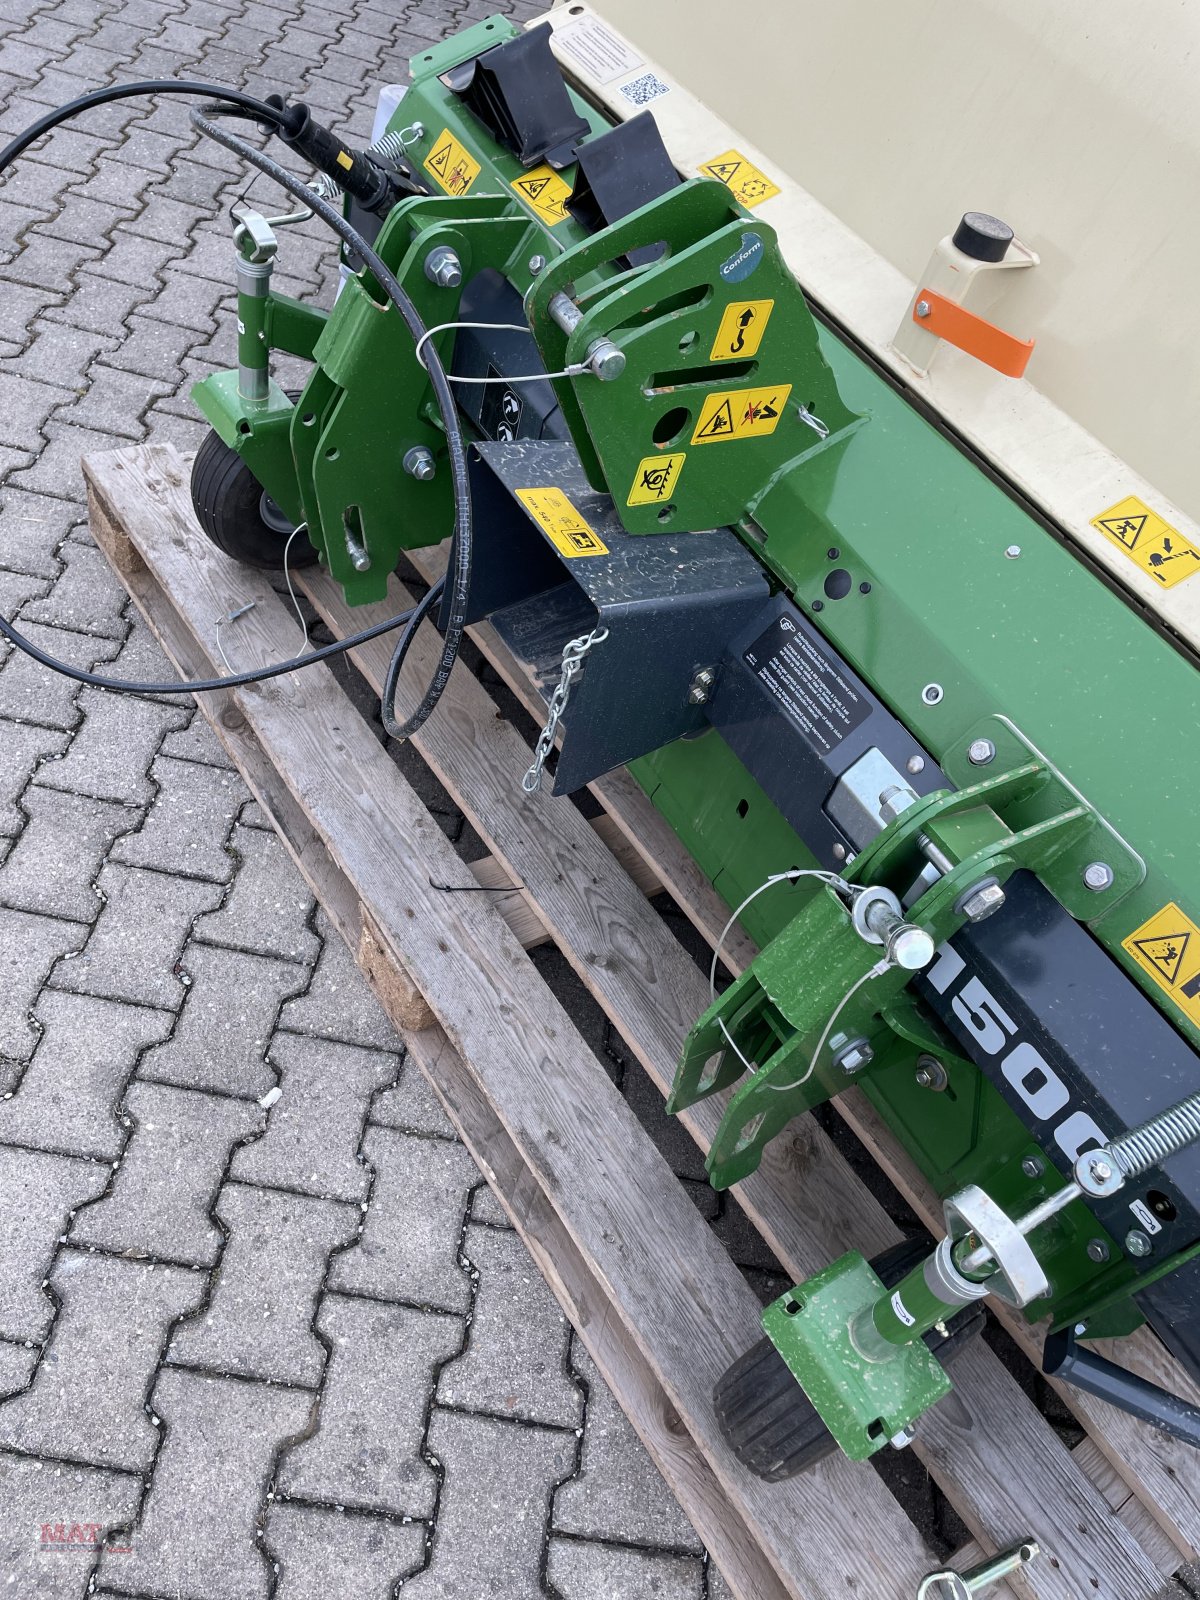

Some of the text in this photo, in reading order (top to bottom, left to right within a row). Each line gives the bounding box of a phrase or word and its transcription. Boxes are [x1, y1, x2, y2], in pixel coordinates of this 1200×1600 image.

[723, 242, 761, 274] Conform
[449, 429, 467, 488] AMAZONE
[527, 496, 539, 510] max.
[539, 511, 551, 522] 540
